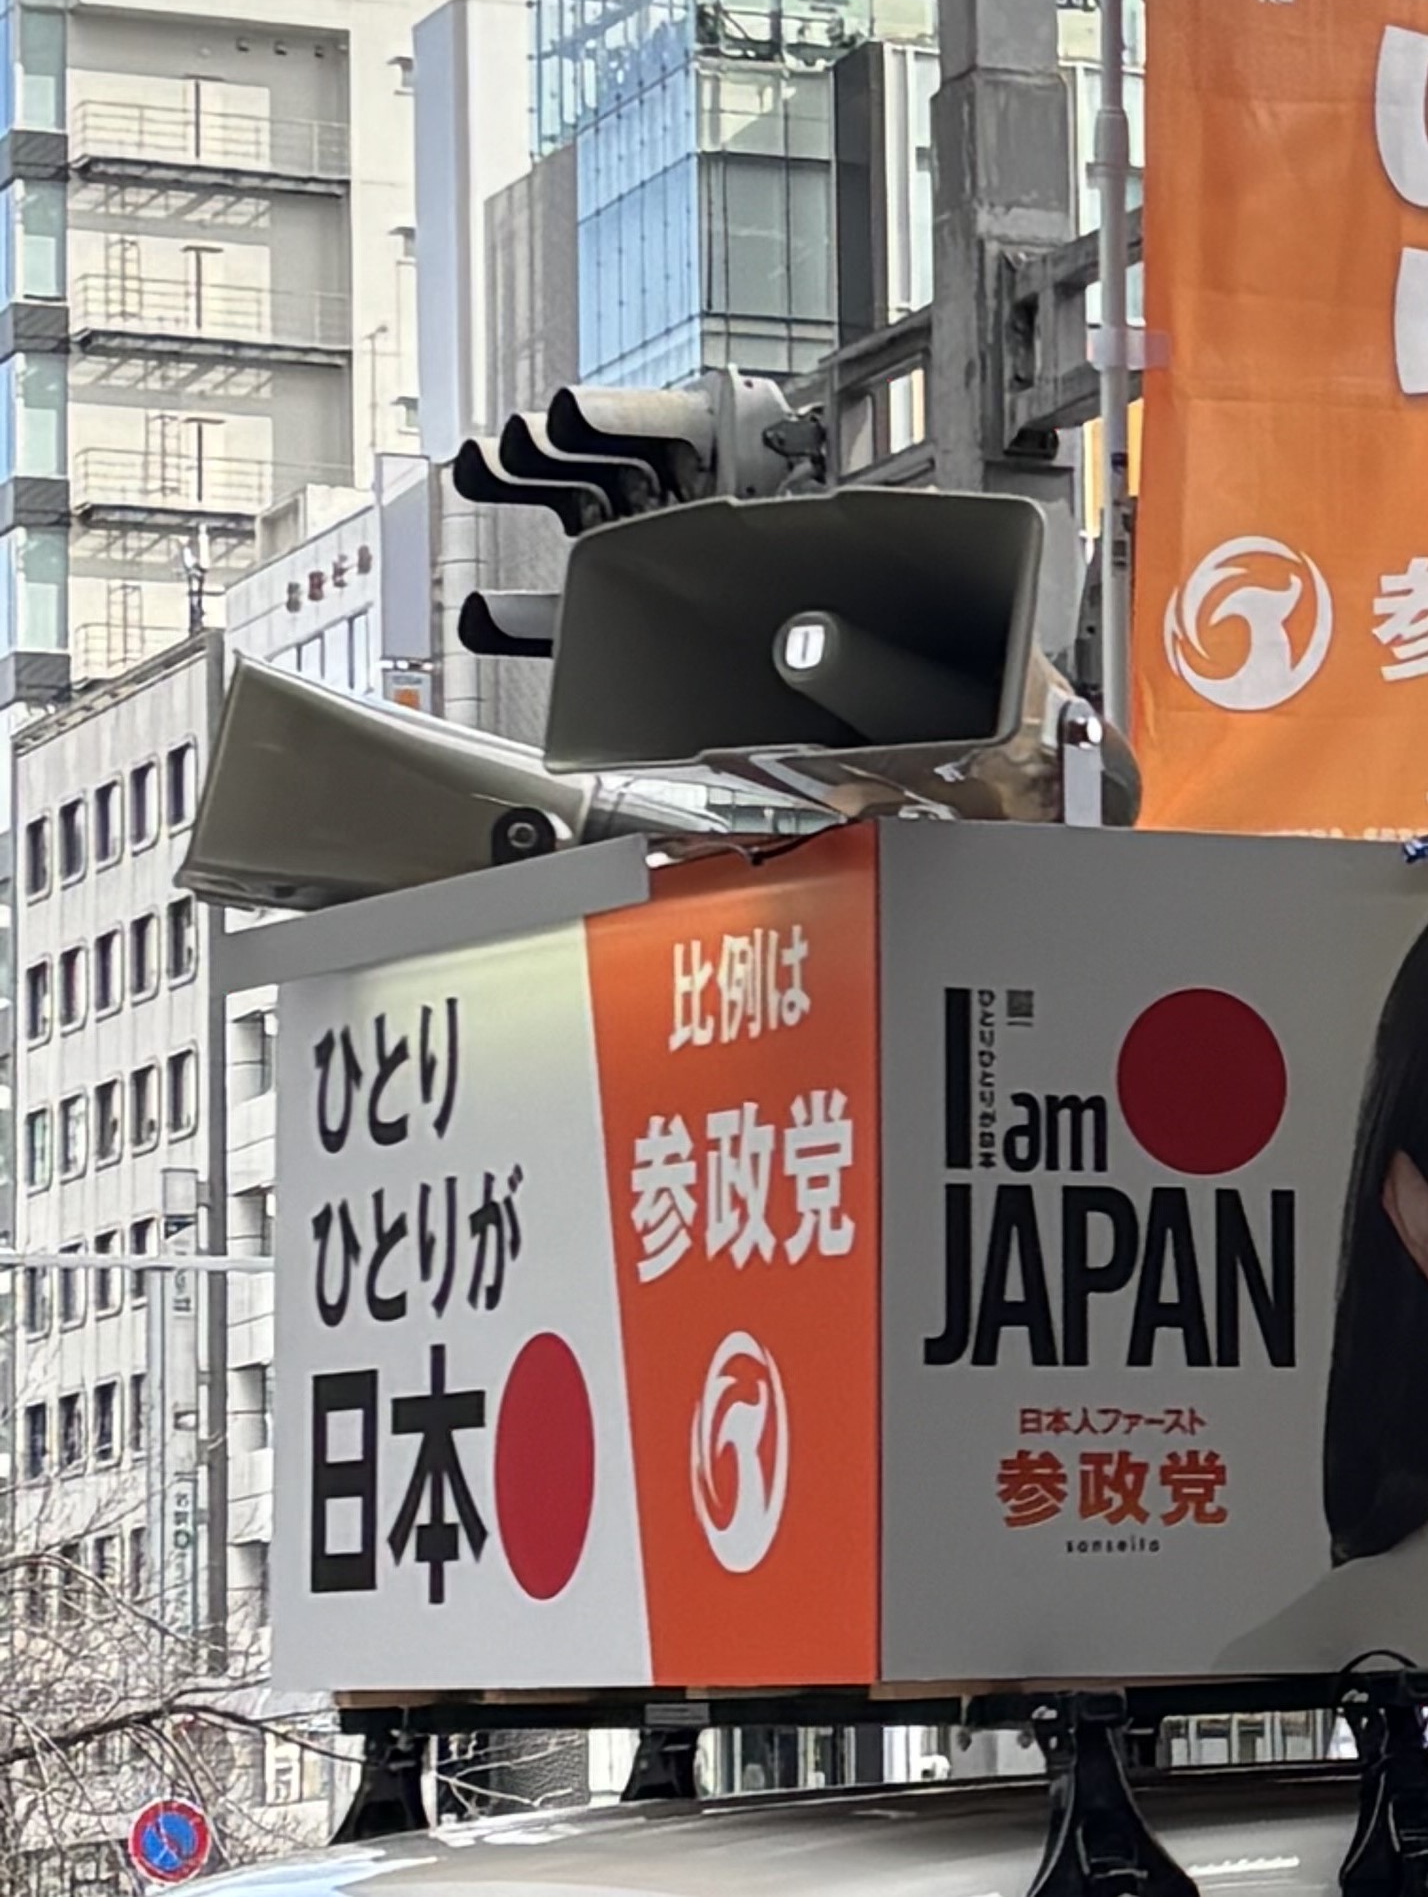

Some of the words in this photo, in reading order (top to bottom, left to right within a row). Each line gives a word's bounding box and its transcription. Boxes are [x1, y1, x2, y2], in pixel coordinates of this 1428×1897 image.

[668, 925, 812, 1053] 比例は
[314, 997, 459, 1153] ひとり
[1003, 1090, 1108, 1173] am
[311, 1164, 525, 1328] ひとりが
[630, 1089, 857, 1284] 参政党
[924, 1183, 1297, 1369] JAPAN
[311, 1343, 488, 1605] 日本
[995, 1449, 1229, 1527] 参政党
[1018, 1407, 1208, 1437] 日本人ファースト
[1066, 1535, 1161, 1556] sanseito
